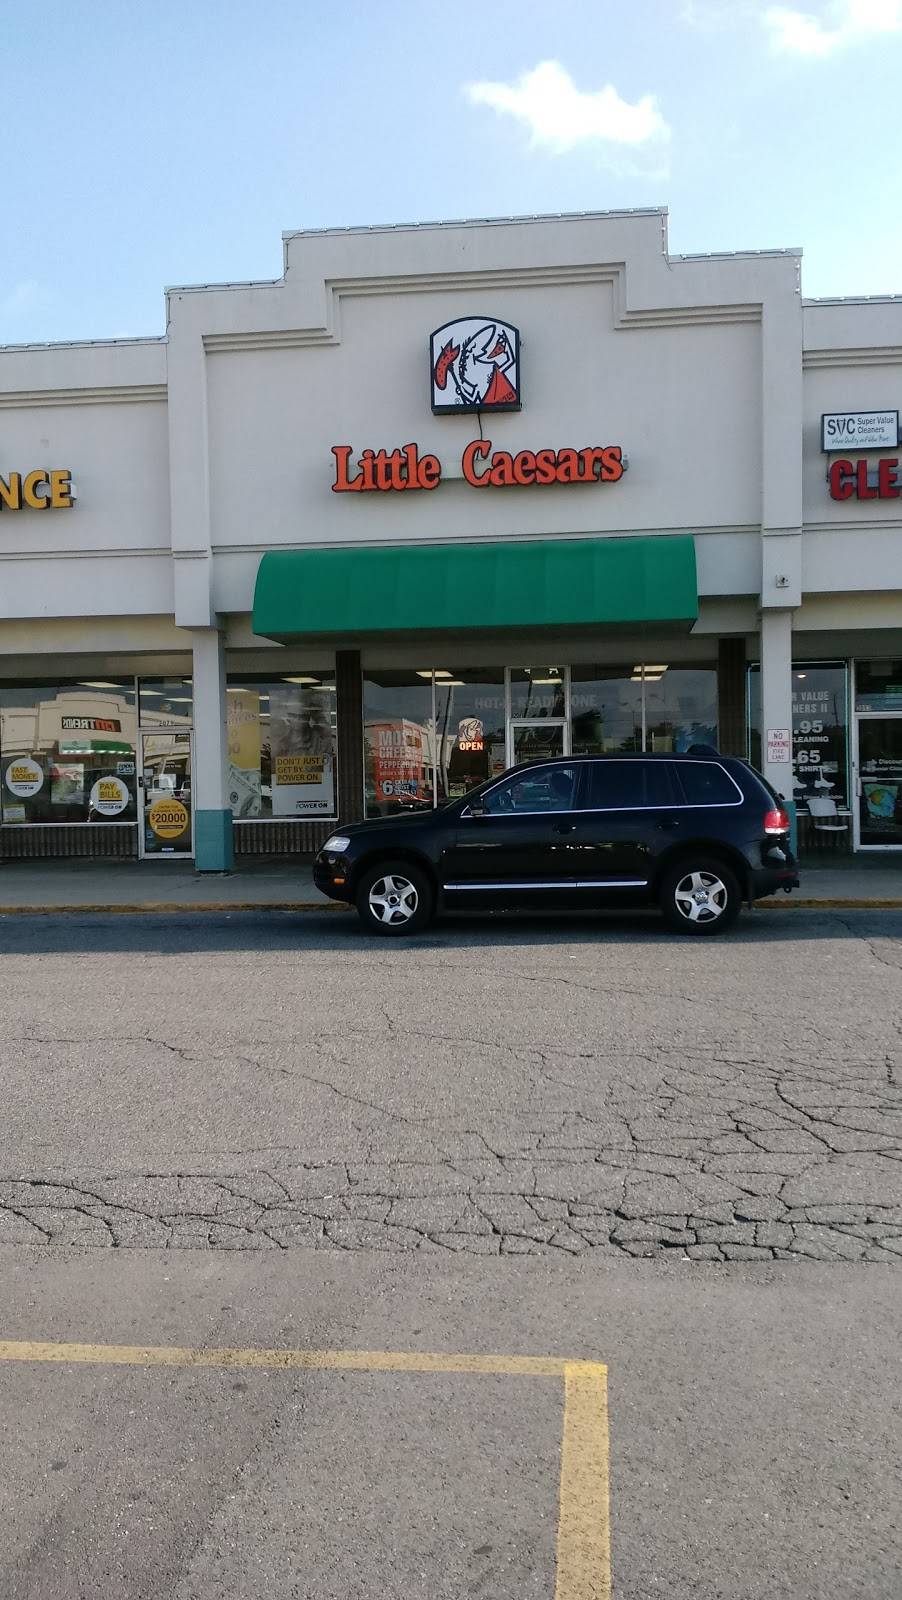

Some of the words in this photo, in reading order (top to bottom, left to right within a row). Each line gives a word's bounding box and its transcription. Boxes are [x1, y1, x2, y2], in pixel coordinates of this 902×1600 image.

[857, 417, 875, 425] Super
[877, 416, 894, 424] Value
[827, 418, 855, 435] SVC
[857, 426, 885, 434] Cleaners
[331, 443, 441, 493] Little
[462, 440, 624, 487] Caesars
[0, 469, 73, 510] NCE
[571, 694, 597, 707] ONE
[801, 691, 830, 701] VALUE
[793, 703, 817, 713] NERS
[793, 720, 823, 735] .95
[773, 732, 783, 740] NO
[459, 741, 484, 751] OPEN
[277, 758, 300, 766] DON'T
[302, 757, 321, 765] JUST
[278, 774, 305, 782] POWER
[306, 773, 318, 781] ON
[99, 783, 116, 791] PAY
[99, 791, 121, 799] BILLS
[152, 813, 186, 824] $20,000
